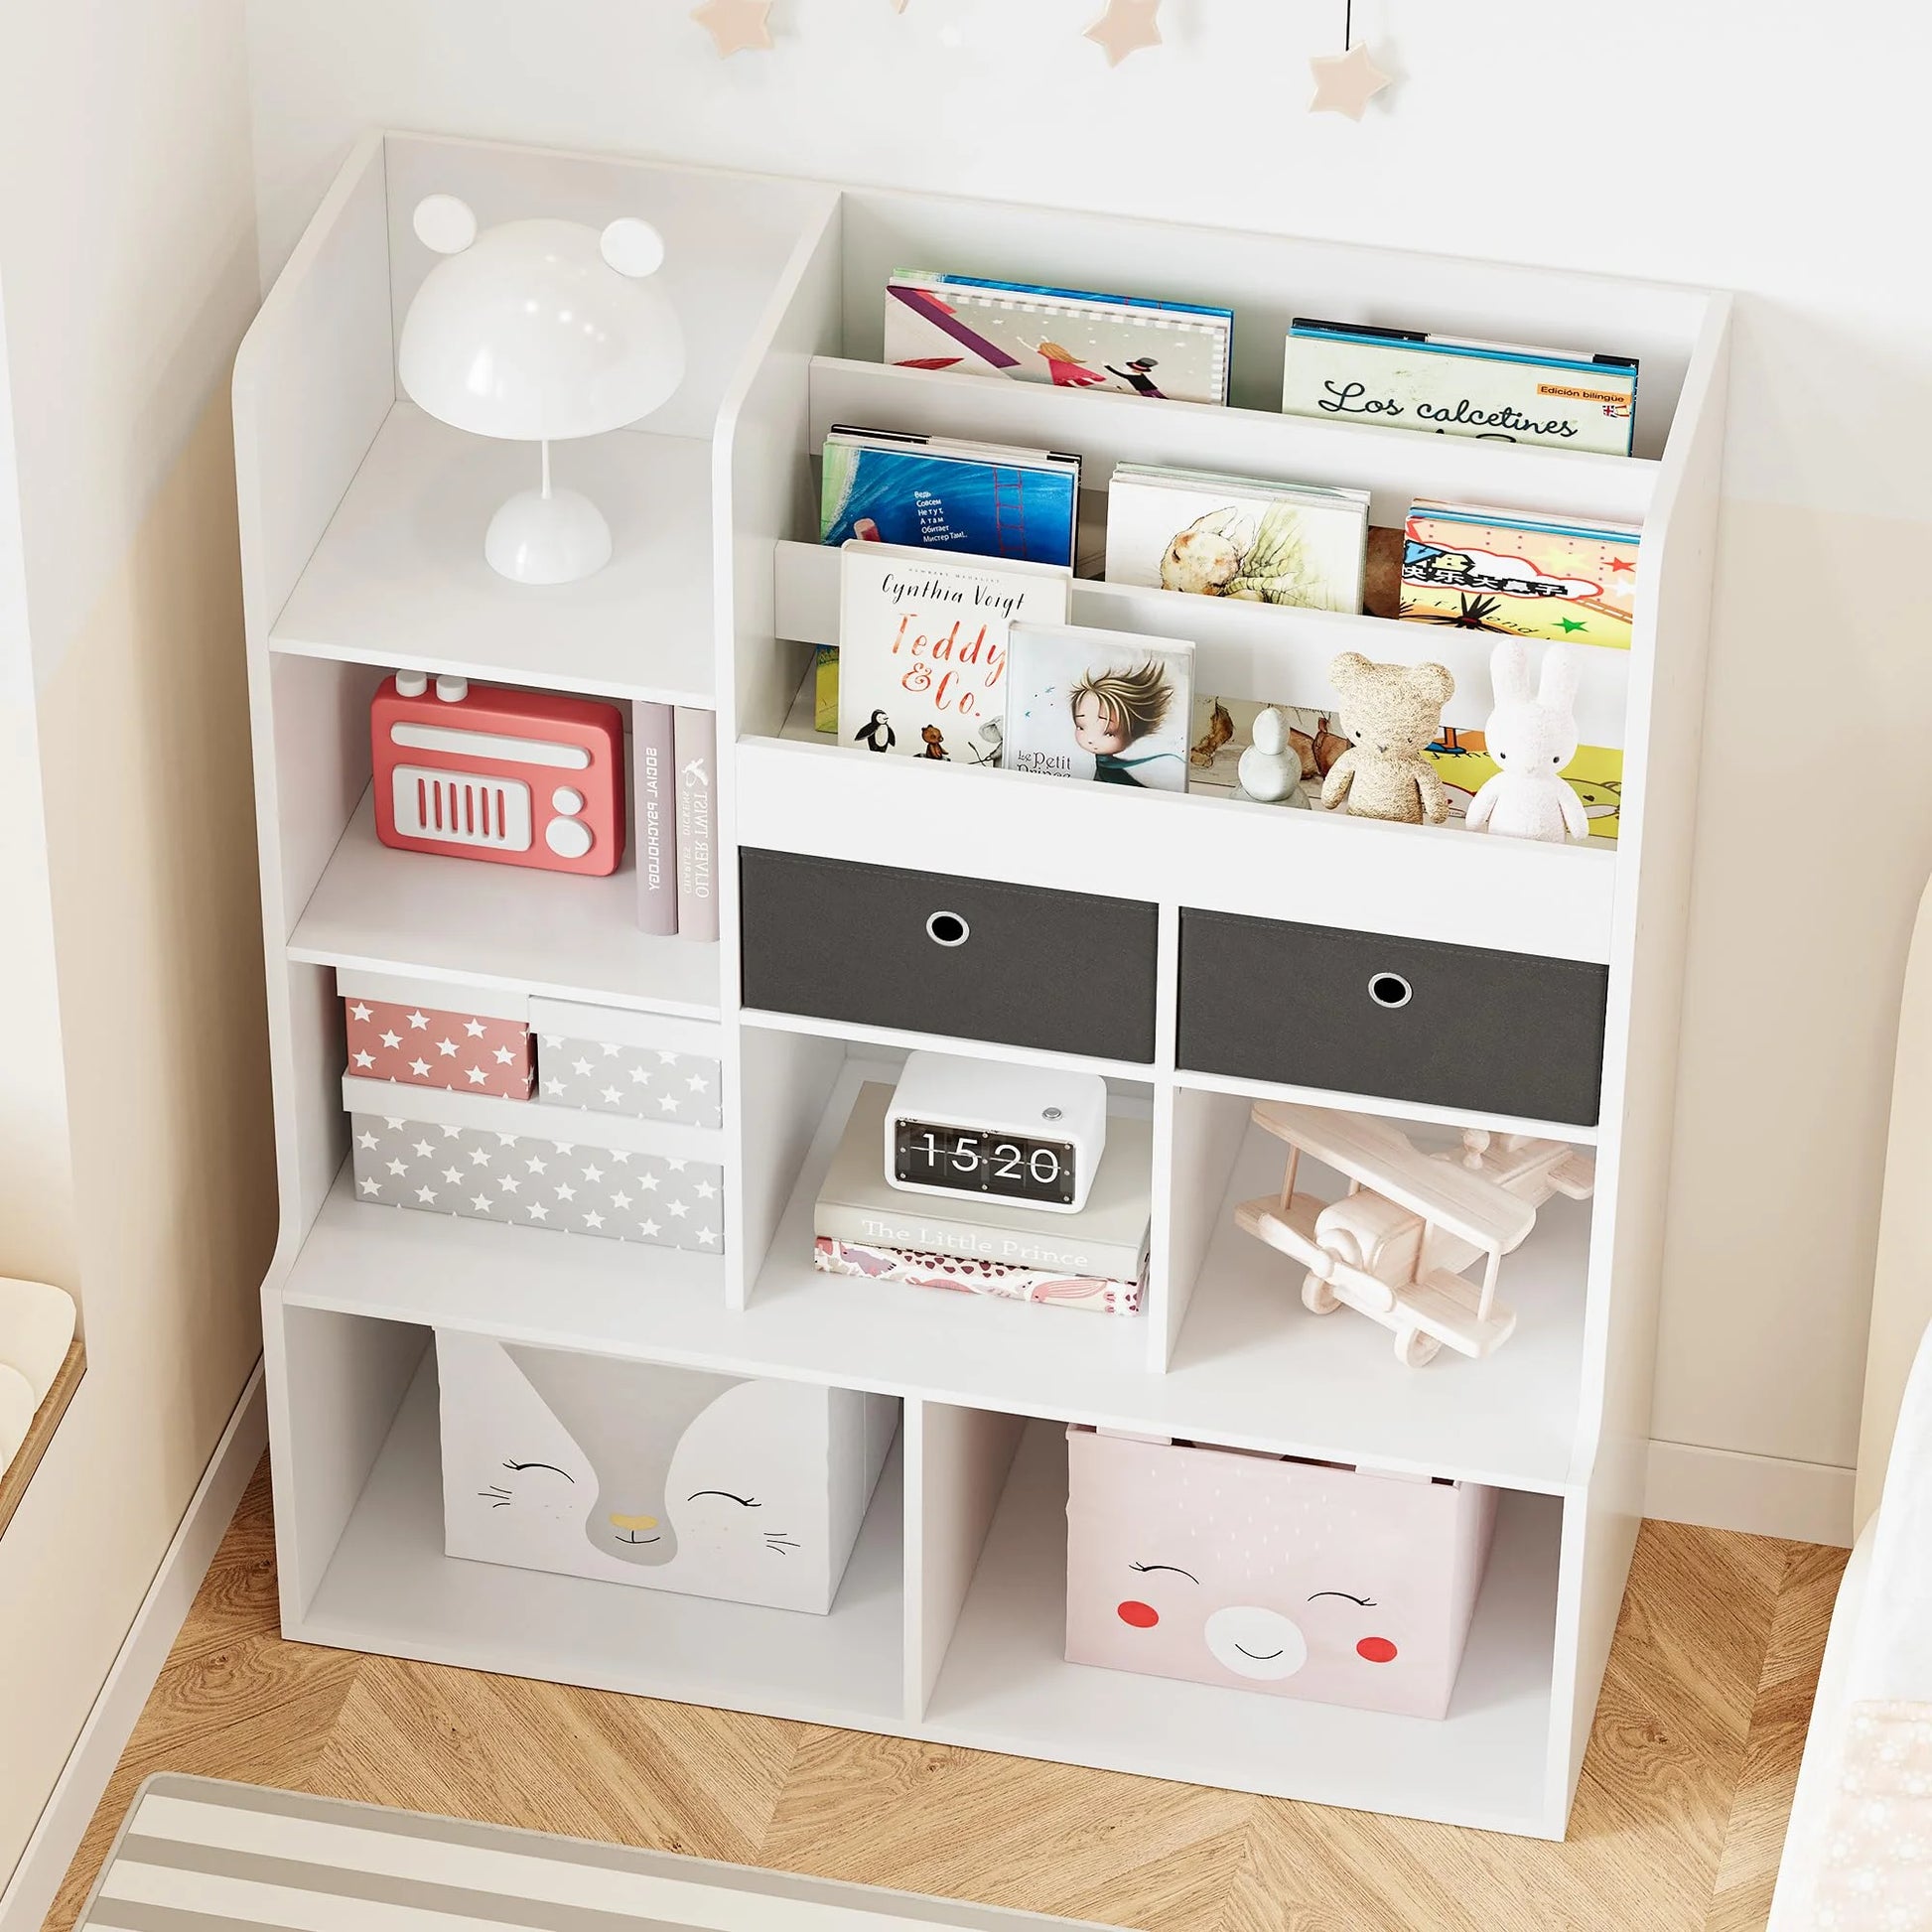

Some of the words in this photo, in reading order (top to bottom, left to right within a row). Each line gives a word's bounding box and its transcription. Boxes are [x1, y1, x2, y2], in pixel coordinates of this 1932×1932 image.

[1317, 379, 1404, 415] Los
[1416, 399, 1579, 437] calcetines
[1541, 386, 1580, 397] Edición
[1583, 391, 1625, 403] bilingüe
[882, 573, 963, 604] Cynthia
[973, 585, 1025, 619] Voigt
[891, 613, 1006, 687] Teddy
[1018, 751, 1032, 761] Le
[1034, 752, 1070, 769] Petit
[862, 1219, 910, 1242] The
[919, 1228, 992, 1254] Little
[1000, 1242, 1089, 1268] Prince
